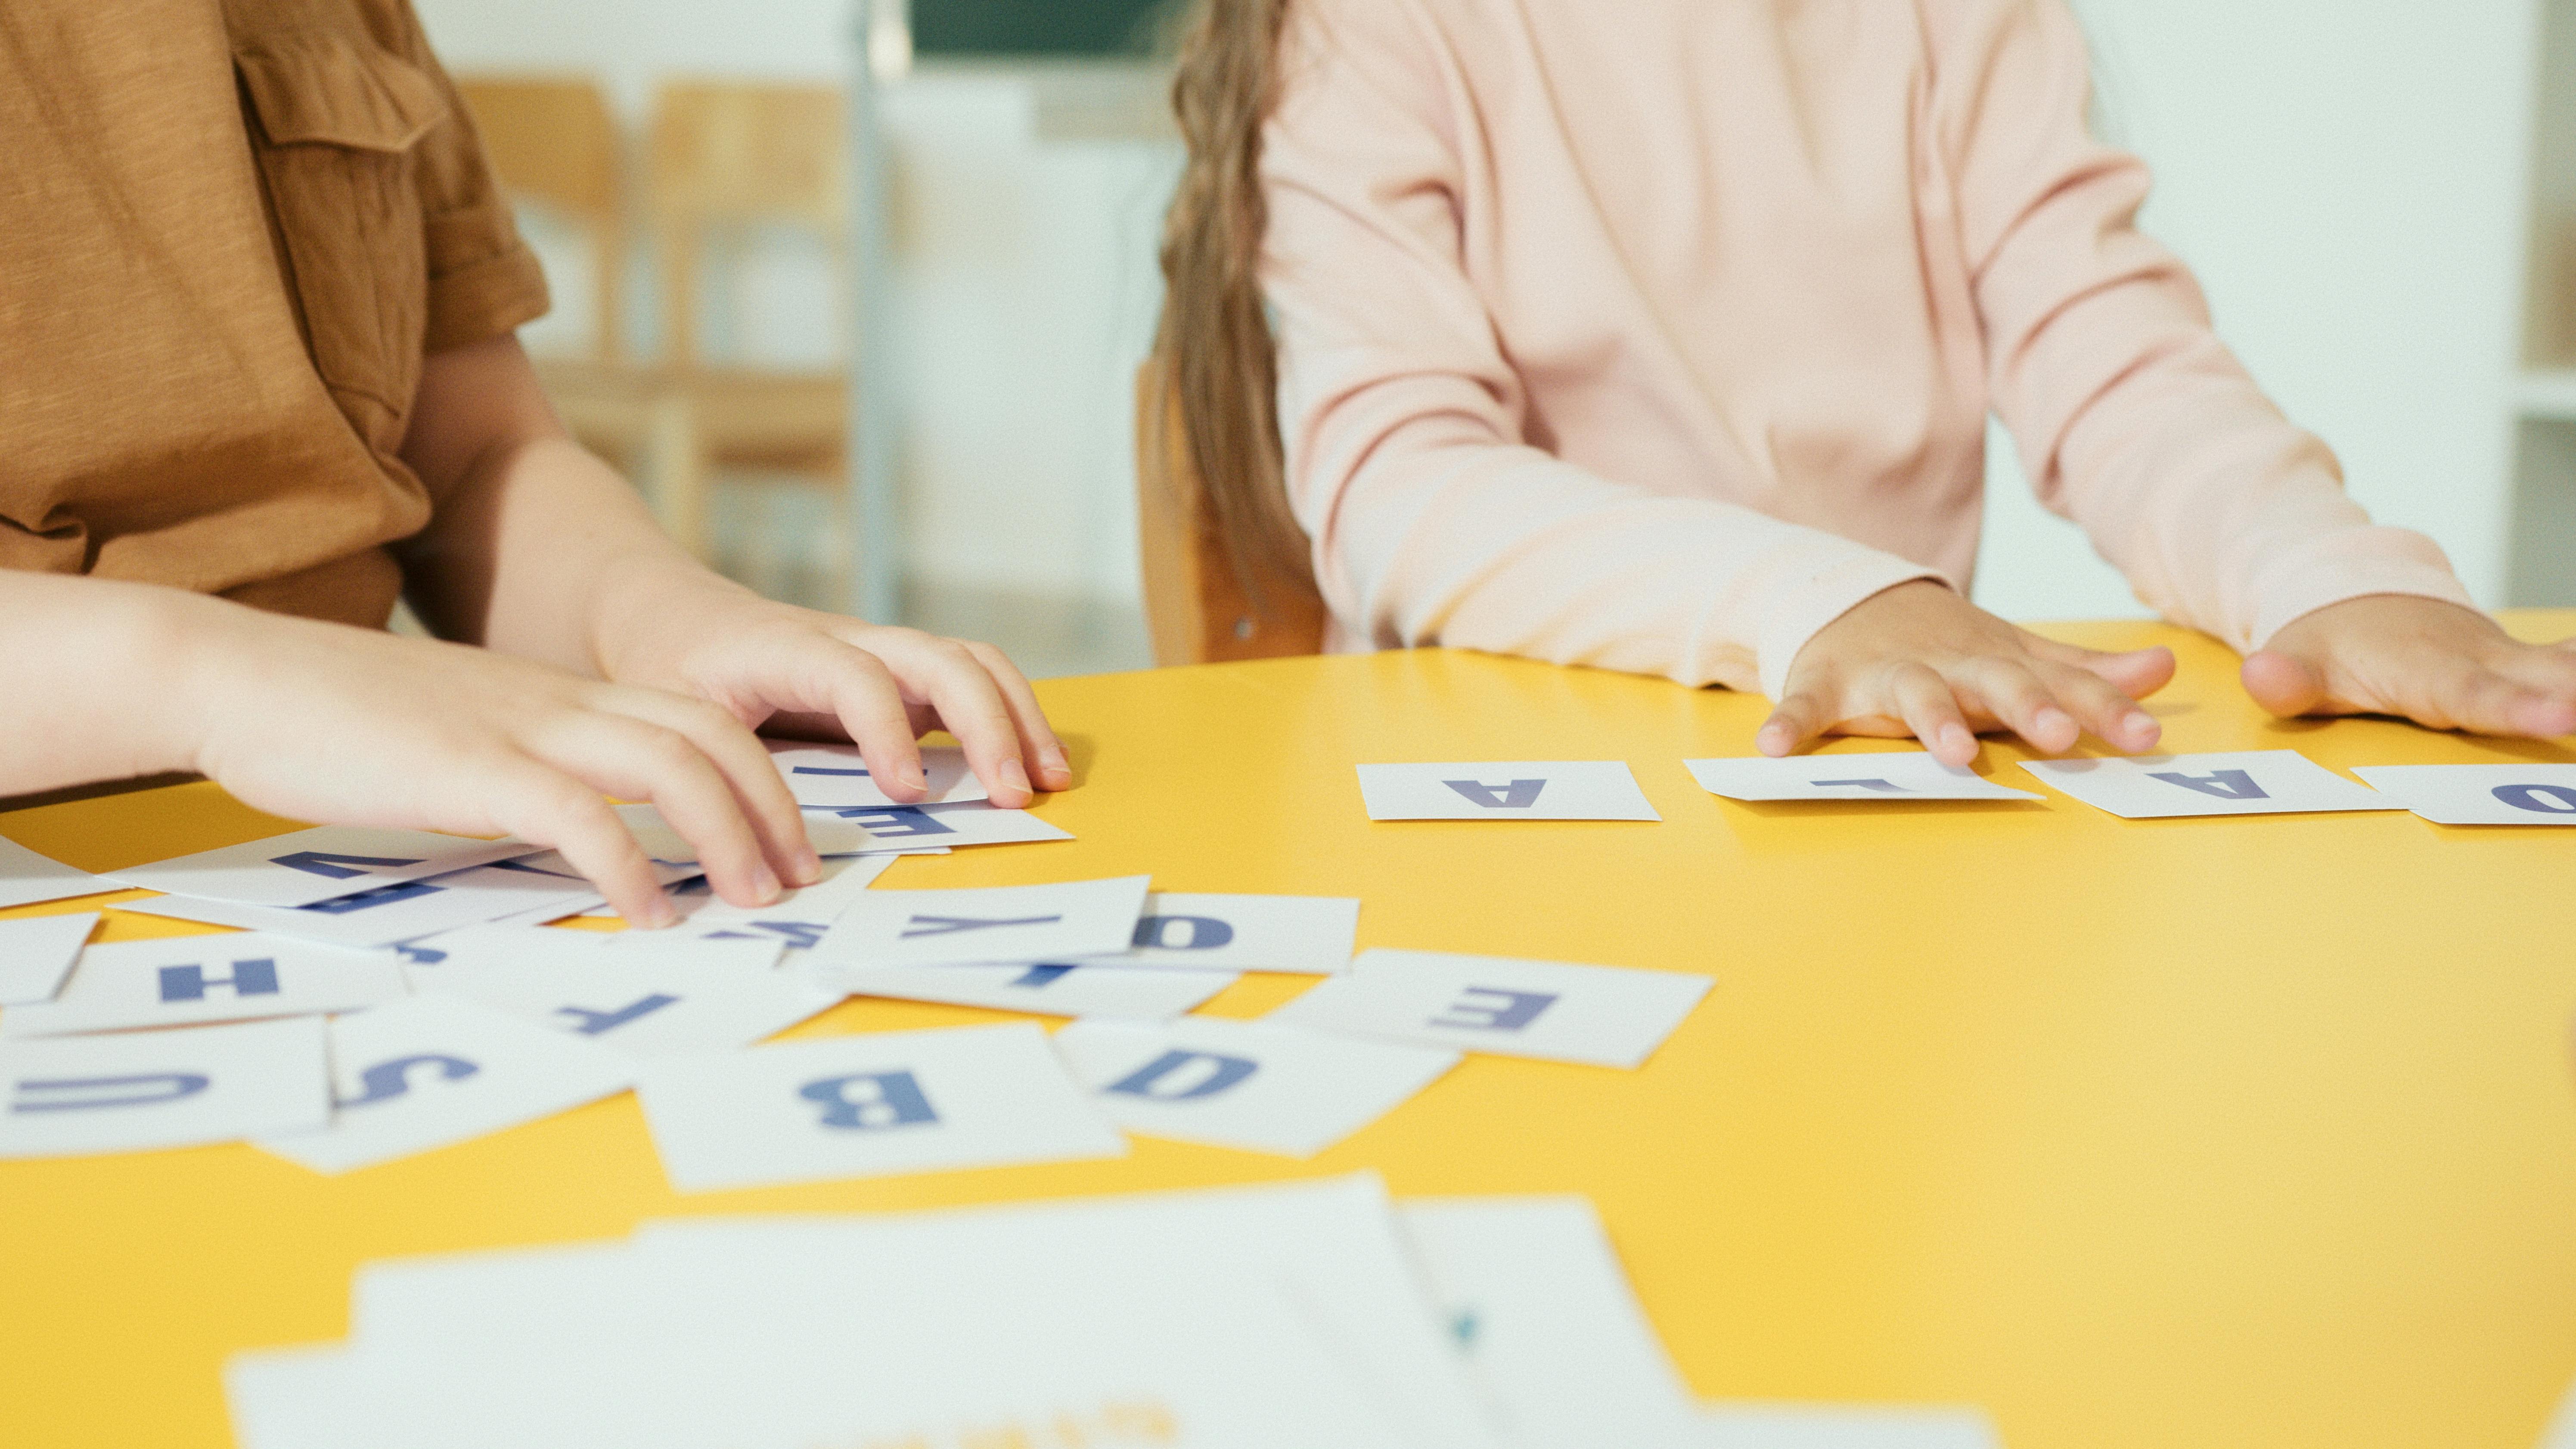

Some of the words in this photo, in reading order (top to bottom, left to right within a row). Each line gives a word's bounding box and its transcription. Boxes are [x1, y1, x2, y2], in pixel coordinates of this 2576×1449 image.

[1441, 779, 1547, 808] A
[2144, 769, 2271, 799] A
[836, 806, 957, 838] E
[899, 915, 1062, 938] Y
[158, 957, 280, 1003] H
[1426, 986, 1559, 1033] E
[11, 1072, 211, 1114] U
[334, 1052, 480, 1108] S
[1100, 1048, 1260, 1100] D
[798, 1069, 943, 1132] B
